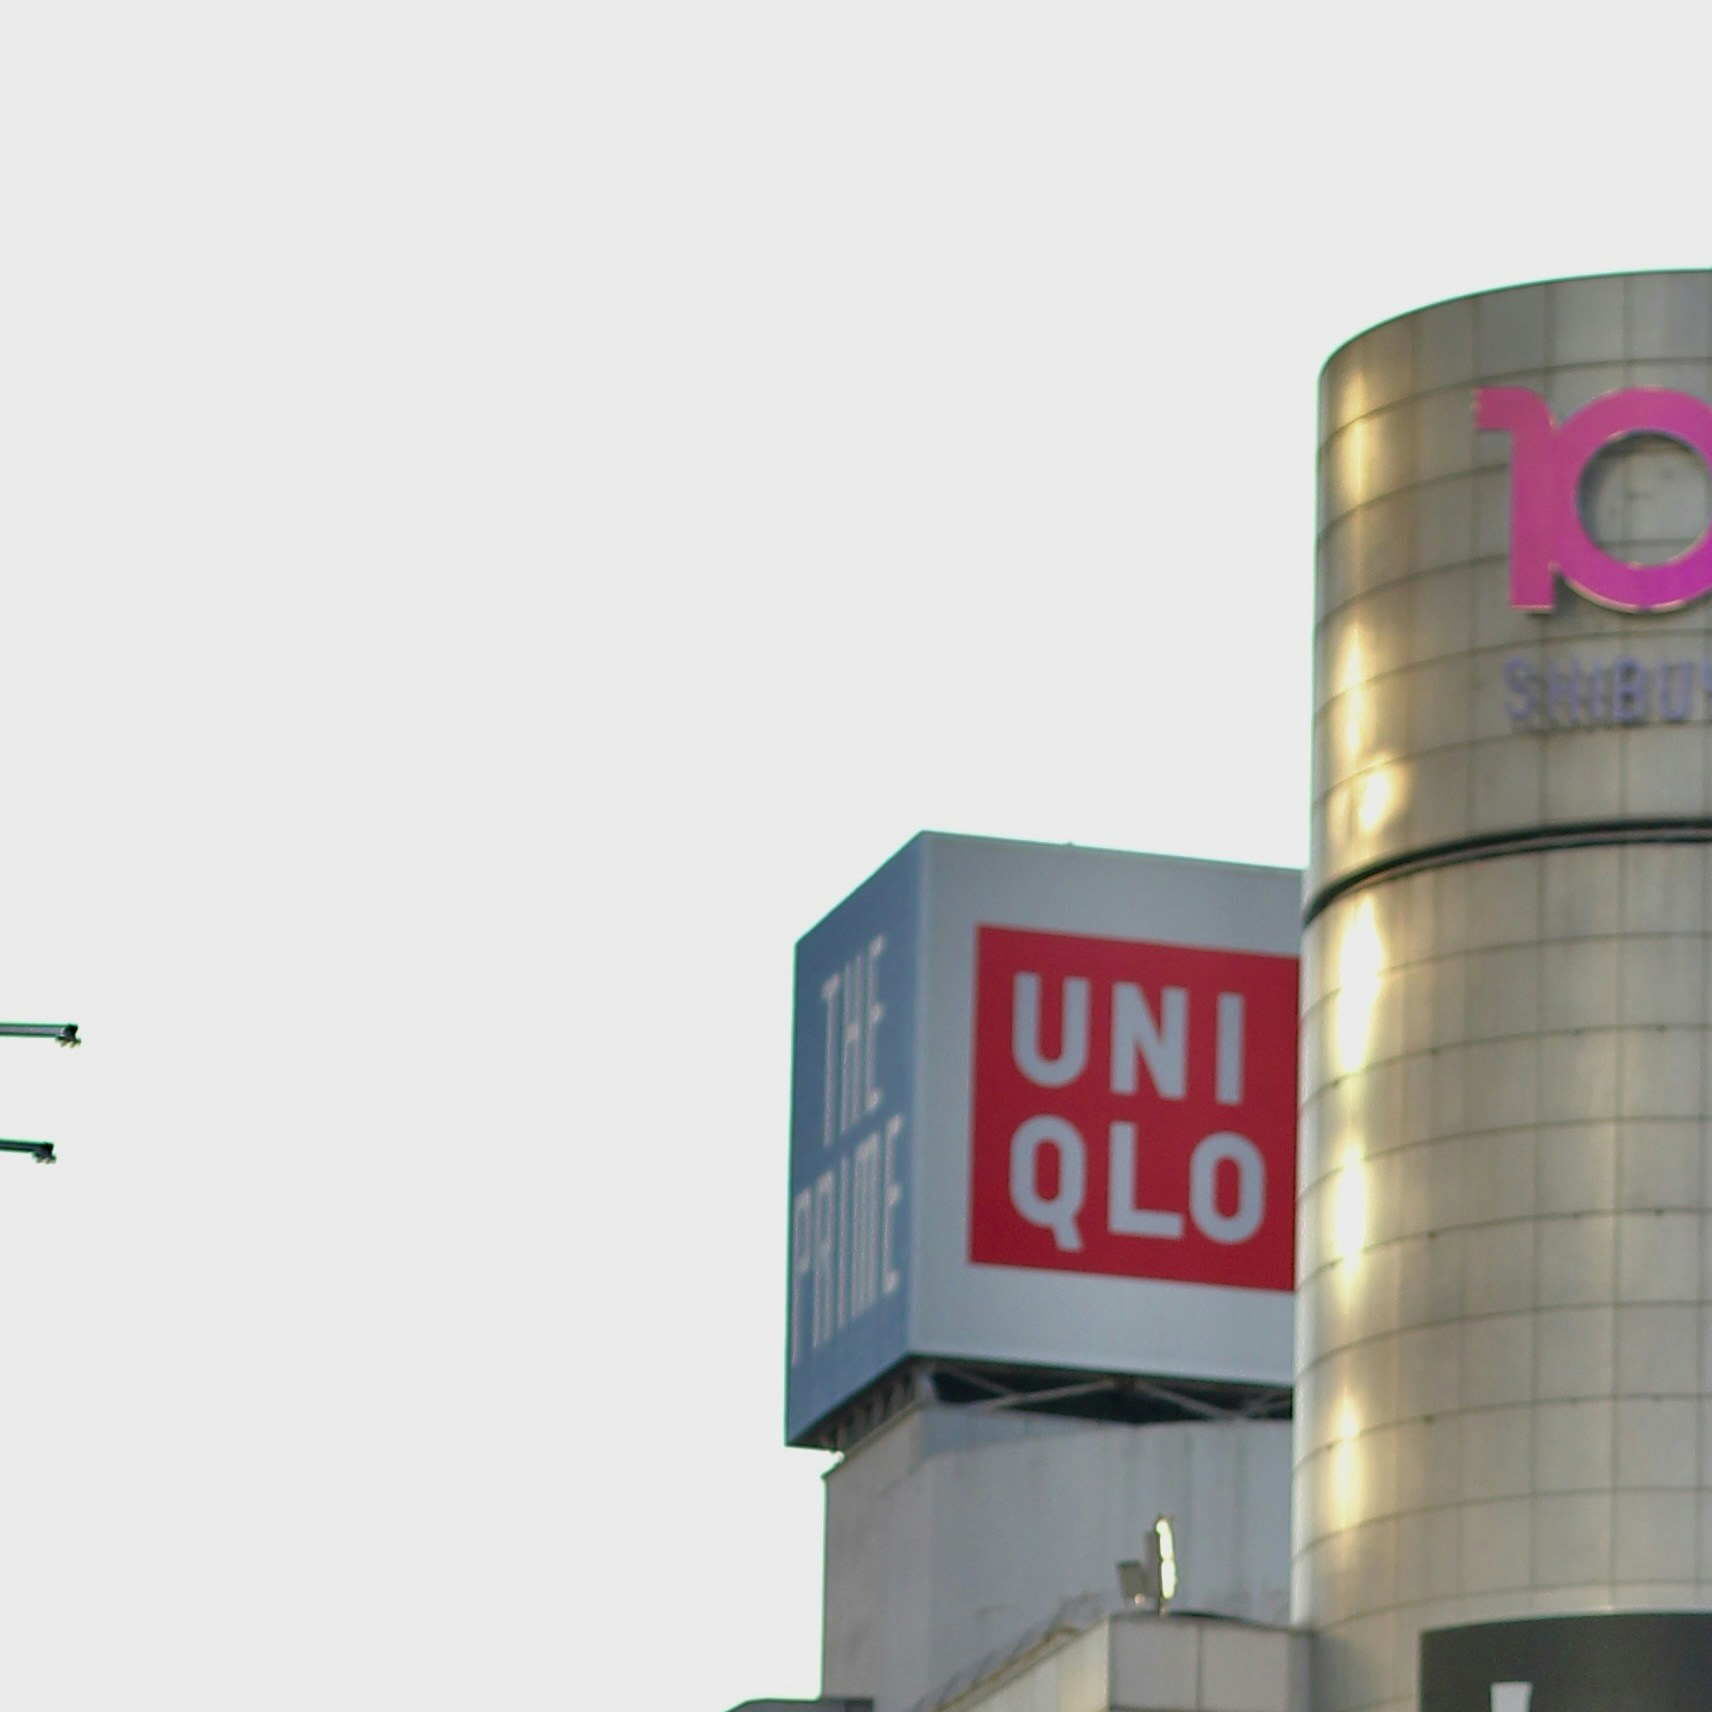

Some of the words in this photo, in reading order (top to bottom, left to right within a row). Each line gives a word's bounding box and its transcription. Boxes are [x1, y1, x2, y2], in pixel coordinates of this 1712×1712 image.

[820, 934, 889, 1149] THE
[1010, 971, 1246, 1105] UNI
[1008, 1113, 1267, 1252] QLO
